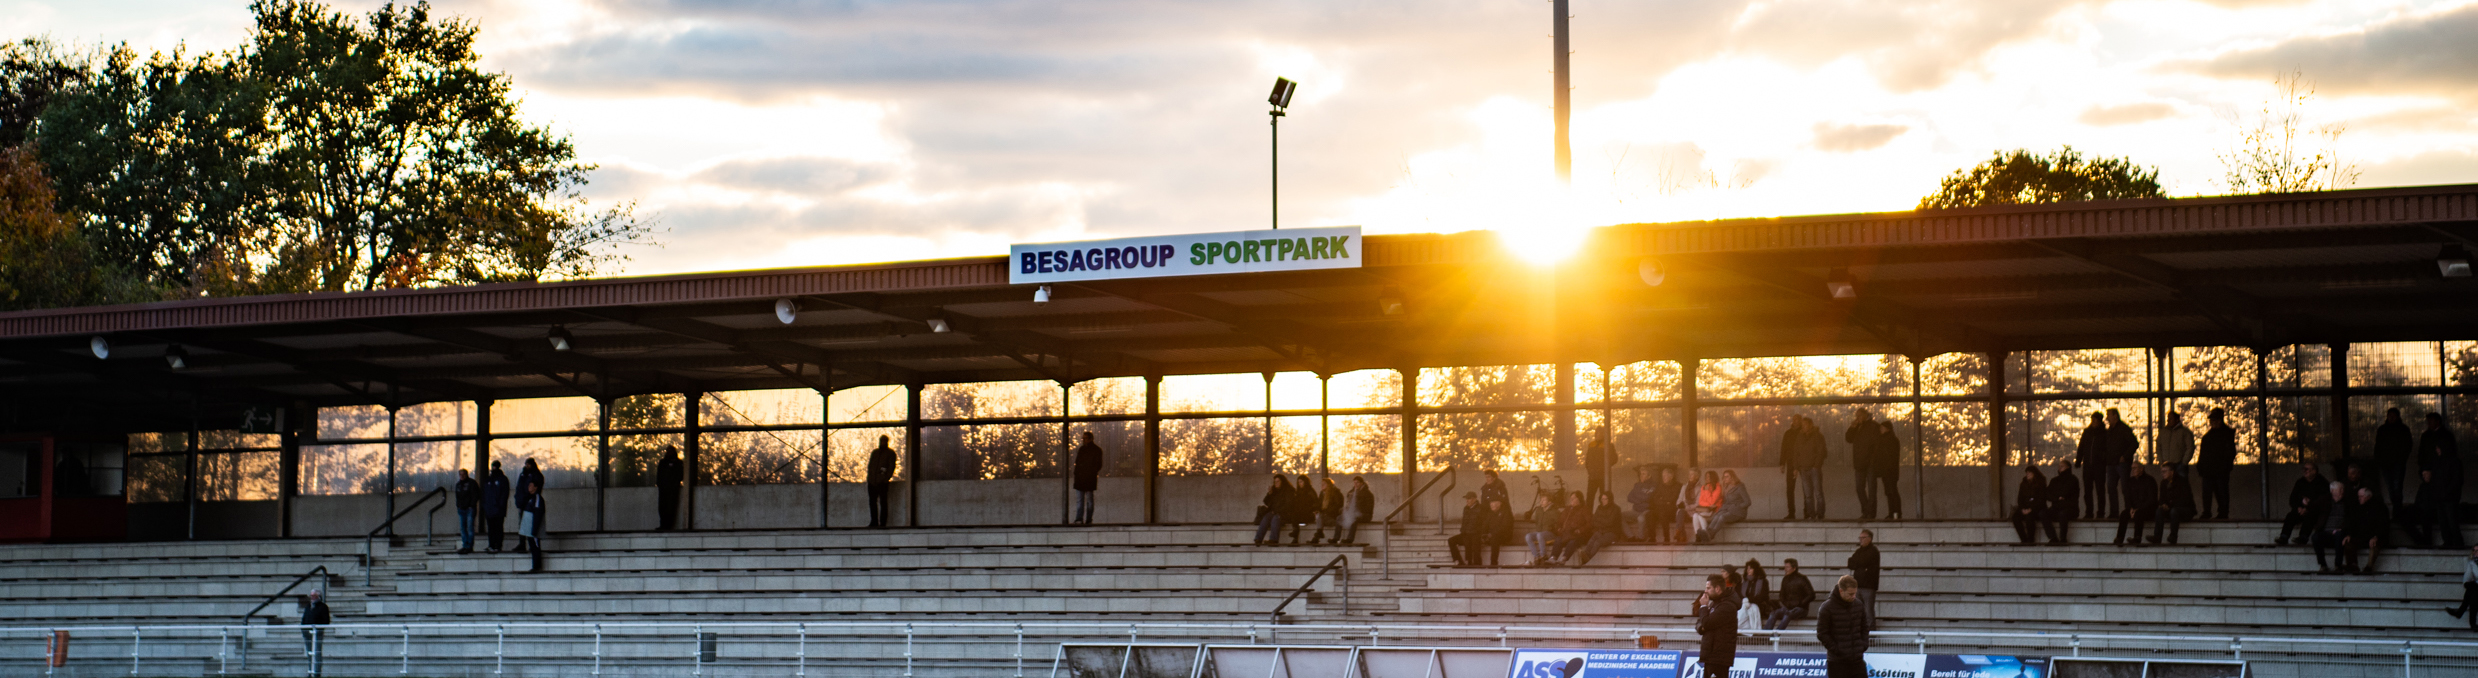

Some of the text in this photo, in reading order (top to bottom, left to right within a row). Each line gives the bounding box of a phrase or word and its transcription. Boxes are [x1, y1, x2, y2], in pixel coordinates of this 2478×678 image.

[1021, 235, 1349, 274] BESAGROUP SPORTPARK
[1868, 668, 1916, 678] Stölting
[1930, 669, 1957, 678] Bereit
[1958, 669, 1971, 678] für
